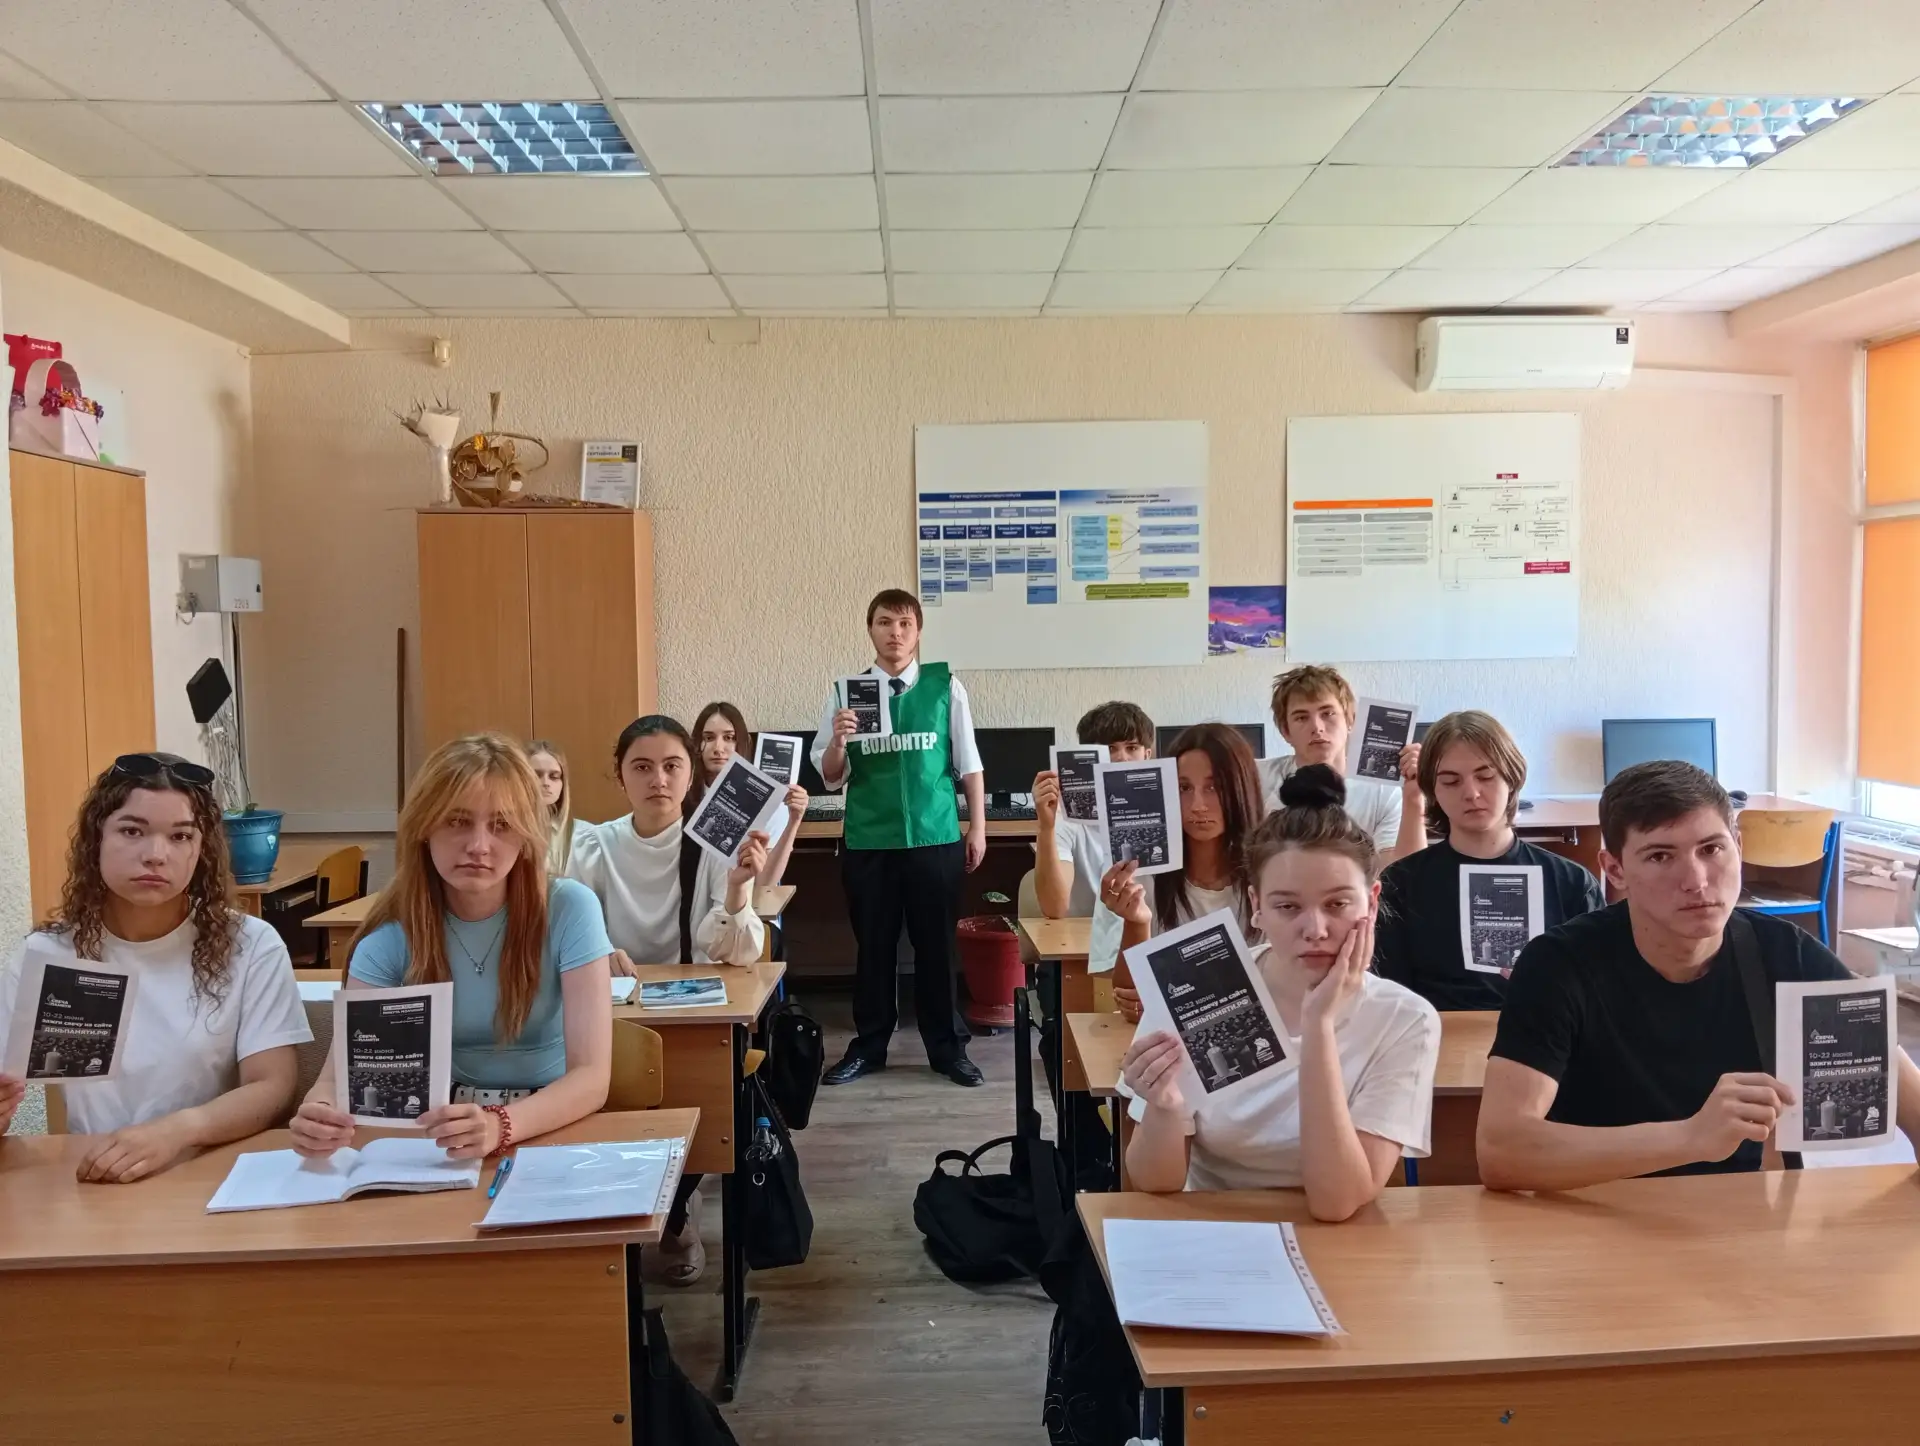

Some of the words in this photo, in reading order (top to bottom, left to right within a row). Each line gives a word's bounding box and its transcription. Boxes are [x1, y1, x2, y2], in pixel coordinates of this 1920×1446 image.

[861, 732, 938, 755] ВОЛОНТЕР
[1175, 1001, 1195, 1013] 10-22
[1195, 993, 1215, 1005] июня
[1187, 999, 1249, 1030] ДЕНЬПАМЯТИ.РФ
[45, 1027, 108, 1035] ДЕНЬПАМЯТИ.РФ
[1814, 1066, 1879, 1078] ДЕНЬПАМЯТИ.РФ
